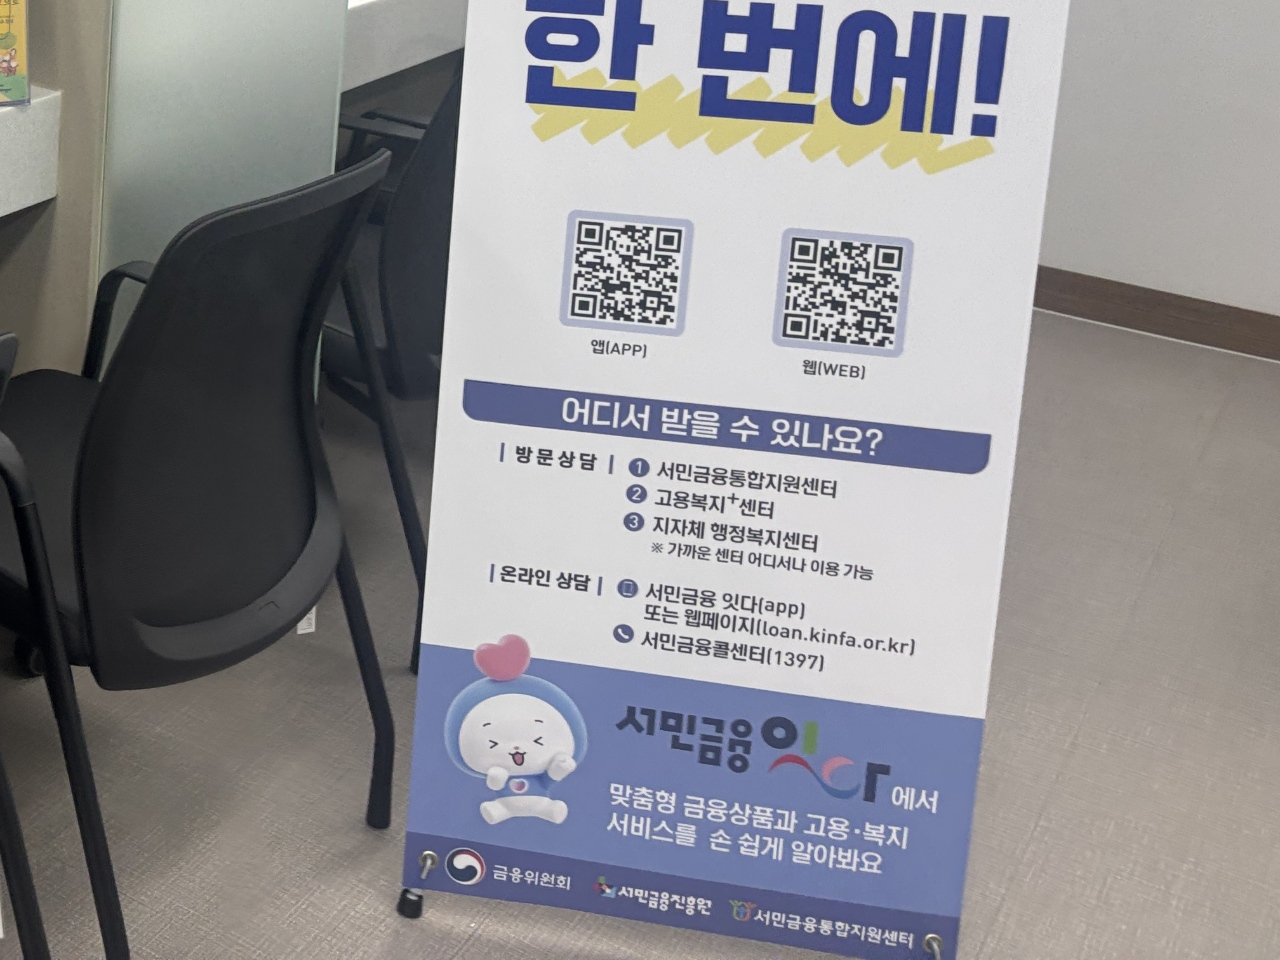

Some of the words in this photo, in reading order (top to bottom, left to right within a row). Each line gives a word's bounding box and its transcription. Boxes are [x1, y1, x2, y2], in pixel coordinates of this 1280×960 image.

[697, 0, 1011, 138] 번에!
[590, 338, 648, 359] 앱(APP)
[802, 358, 866, 381] 웹(WEB)
[561, 397, 651, 433] 어디서
[660, 407, 720, 441] 받을
[730, 413, 760, 444] 수
[770, 418, 885, 456] 있나요?
[656, 460, 838, 500] 서민금융통합지원센터
[652, 514, 705, 541] 지자체
[710, 520, 819, 554] 행정복지센터
[499, 565, 551, 588] 온라인
[556, 570, 592, 593] 상담
[667, 542, 712, 561] 가까운
[715, 546, 745, 566] 센터
[748, 550, 807, 575] 어디서나
[810, 557, 840, 578] 이용
[843, 561, 874, 581] 가능
[643, 604, 679, 624] 또는
[645, 582, 717, 610] 서민금융
[721, 590, 806, 620] 잇다(app)
[641, 628, 825, 672] 서민금융콜센터(1397)
[609, 783, 677, 816] 맞춤형
[682, 793, 798, 832] 금융상품과
[606, 812, 698, 848] 서비스를
[709, 827, 733, 853] 손
[737, 831, 785, 862] 쉽게
[791, 841, 883, 876] 알아봐요
[492, 864, 572, 892] 금융위원회
[617, 884, 713, 917] 서민금융진흥원
[753, 908, 914, 950] 서민금융통합지원센터
